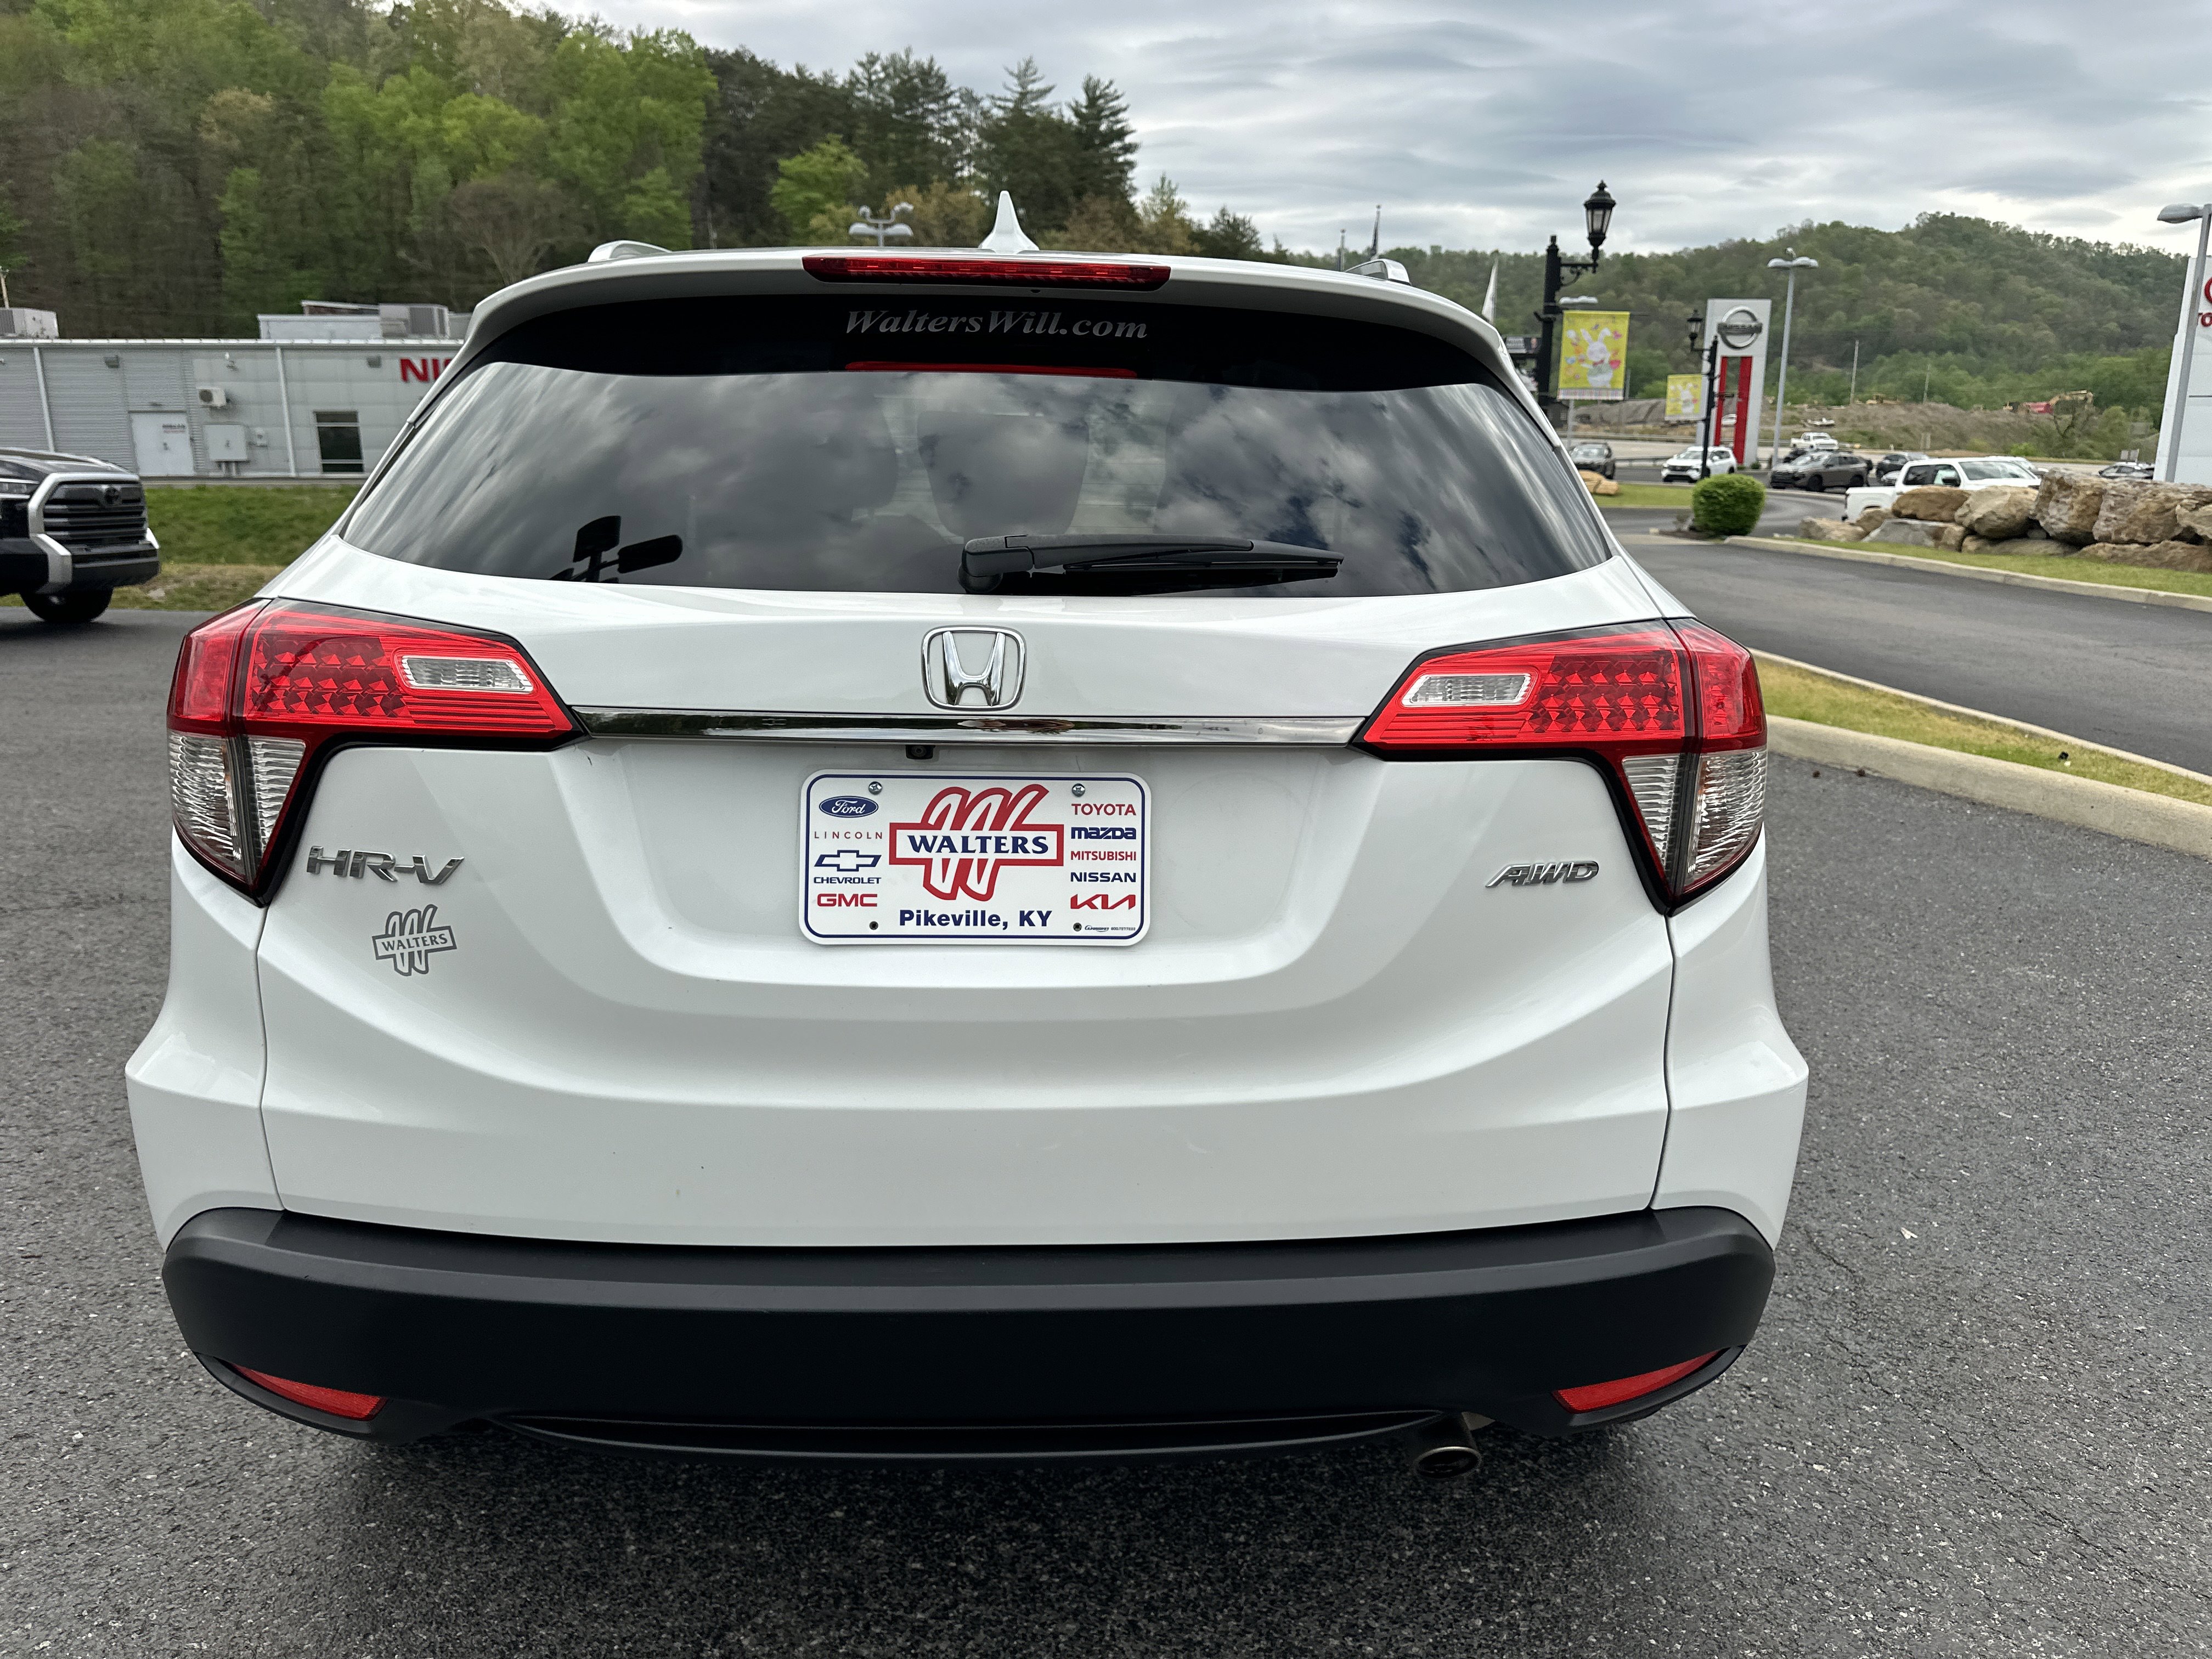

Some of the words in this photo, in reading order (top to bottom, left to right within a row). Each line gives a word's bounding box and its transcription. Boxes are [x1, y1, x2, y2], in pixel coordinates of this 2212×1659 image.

[845, 309, 1148, 338] WaltersWill.com
[831, 799, 866, 814] Ford
[1071, 803, 1137, 816] TOYOTA
[814, 831, 883, 839] LINCOLN
[907, 834, 1049, 854] WALTERS
[1070, 850, 1137, 861] MITSUBISHI
[307, 845, 465, 884] HR-V
[1070, 872, 1136, 883] NISSAN
[1485, 860, 1599, 888] AWD
[817, 893, 878, 907] GMC
[1070, 894, 1136, 910] KIA
[899, 909, 1008, 930] Pikeville,
[1019, 910, 1053, 927] KY
[381, 933, 448, 952] WALTERS
